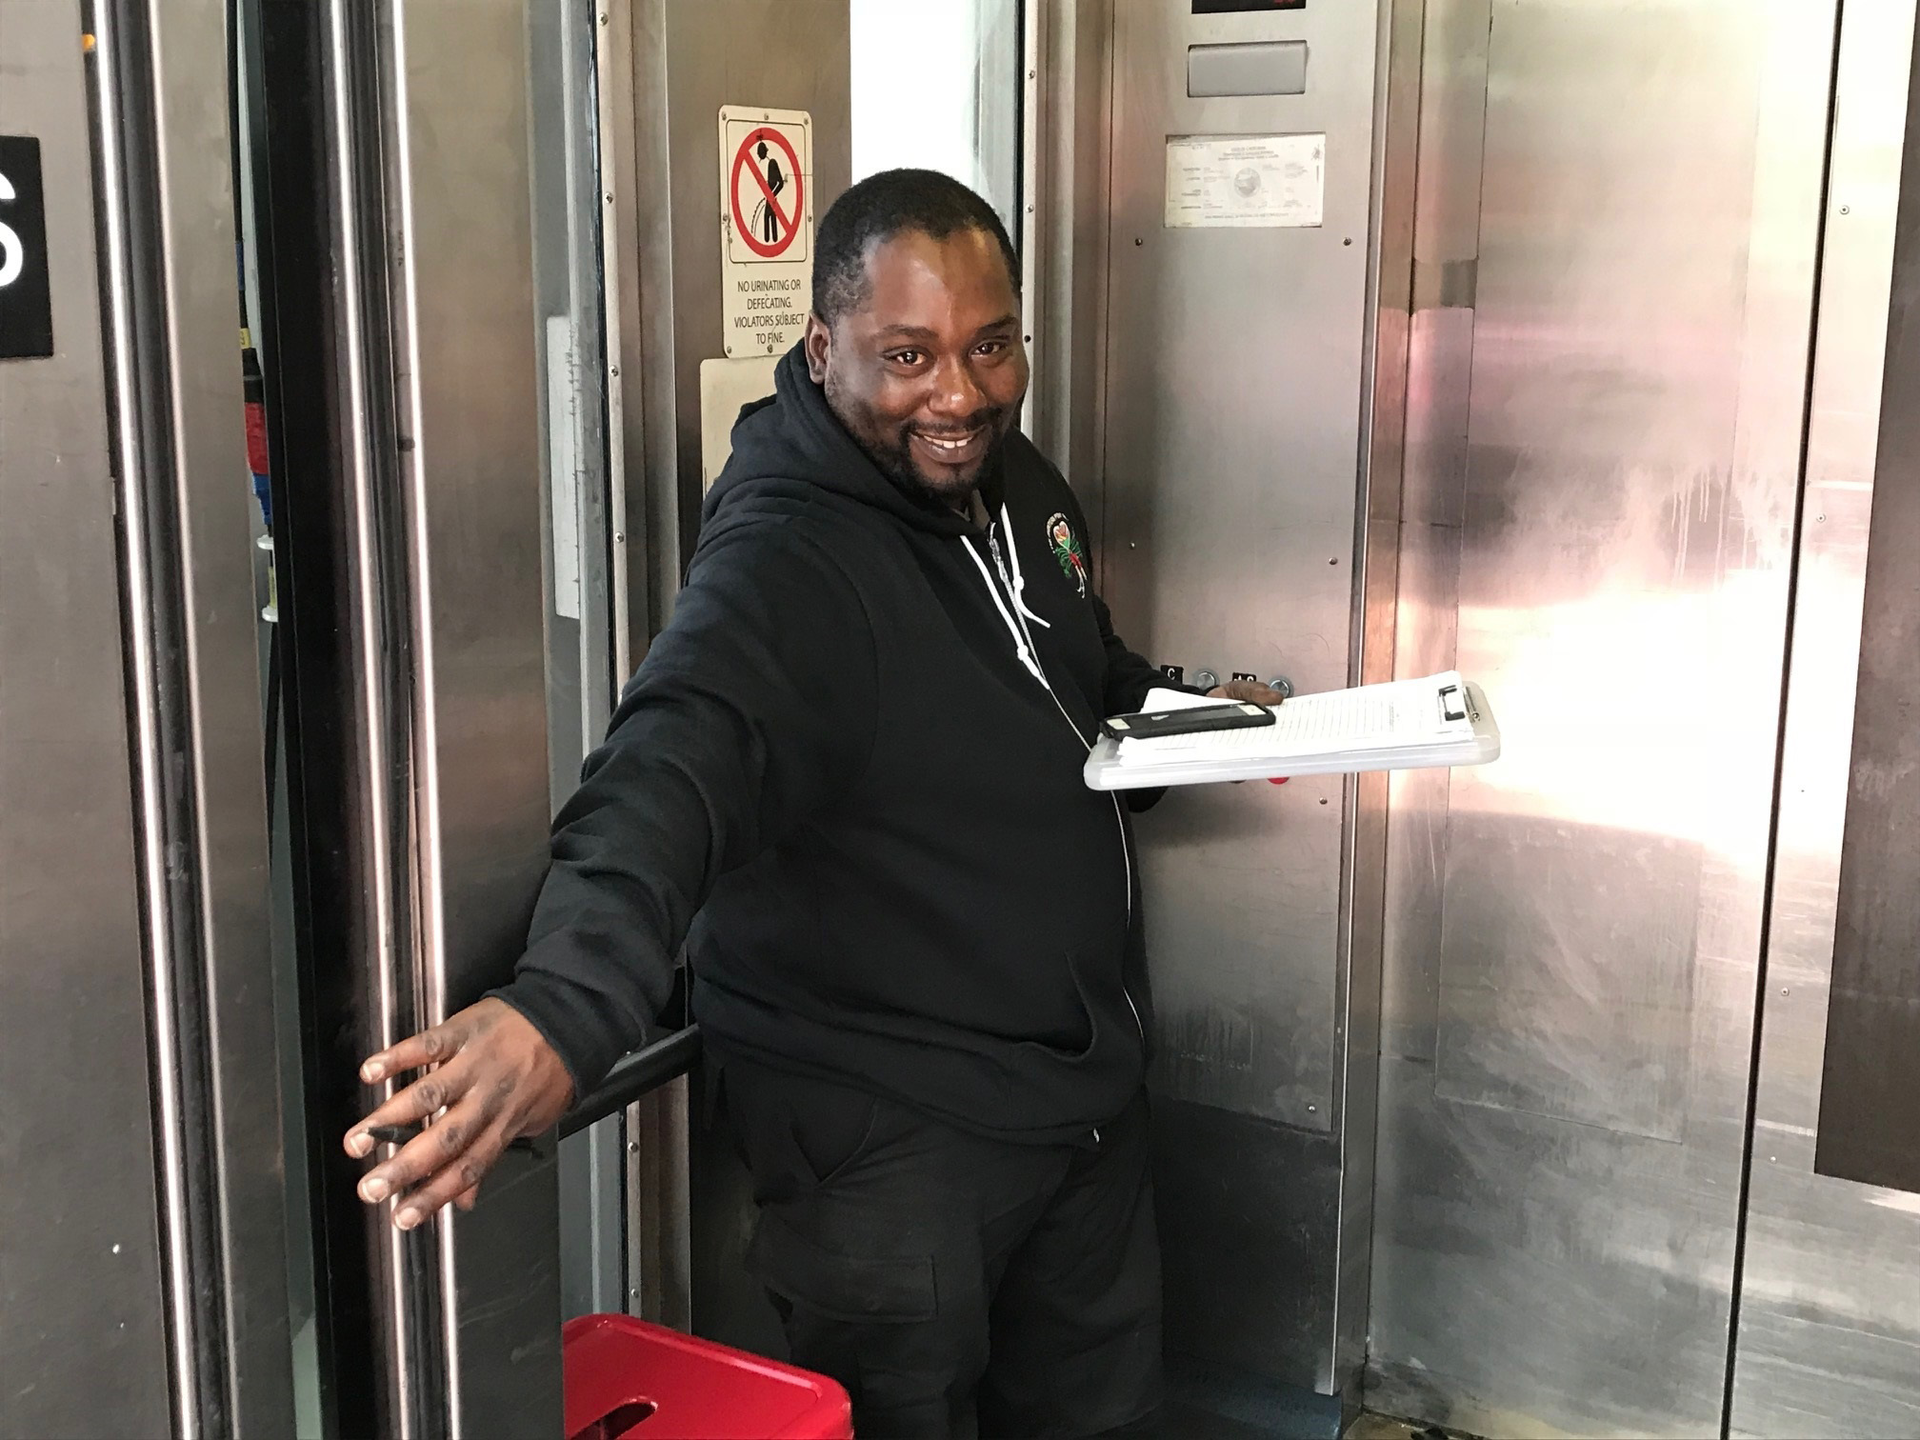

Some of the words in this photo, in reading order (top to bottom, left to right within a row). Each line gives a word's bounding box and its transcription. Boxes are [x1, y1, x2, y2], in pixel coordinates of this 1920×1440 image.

[738, 280, 750, 292] NO
[751, 279, 790, 292] URINATING
[790, 279, 801, 291] OR
[747, 297, 792, 310] DEFECATING.
[734, 315, 774, 328] VIOLATORS
[775, 313, 805, 326] SUBJECT
[756, 333, 767, 344] TO
[767, 332, 785, 344] FINE.
